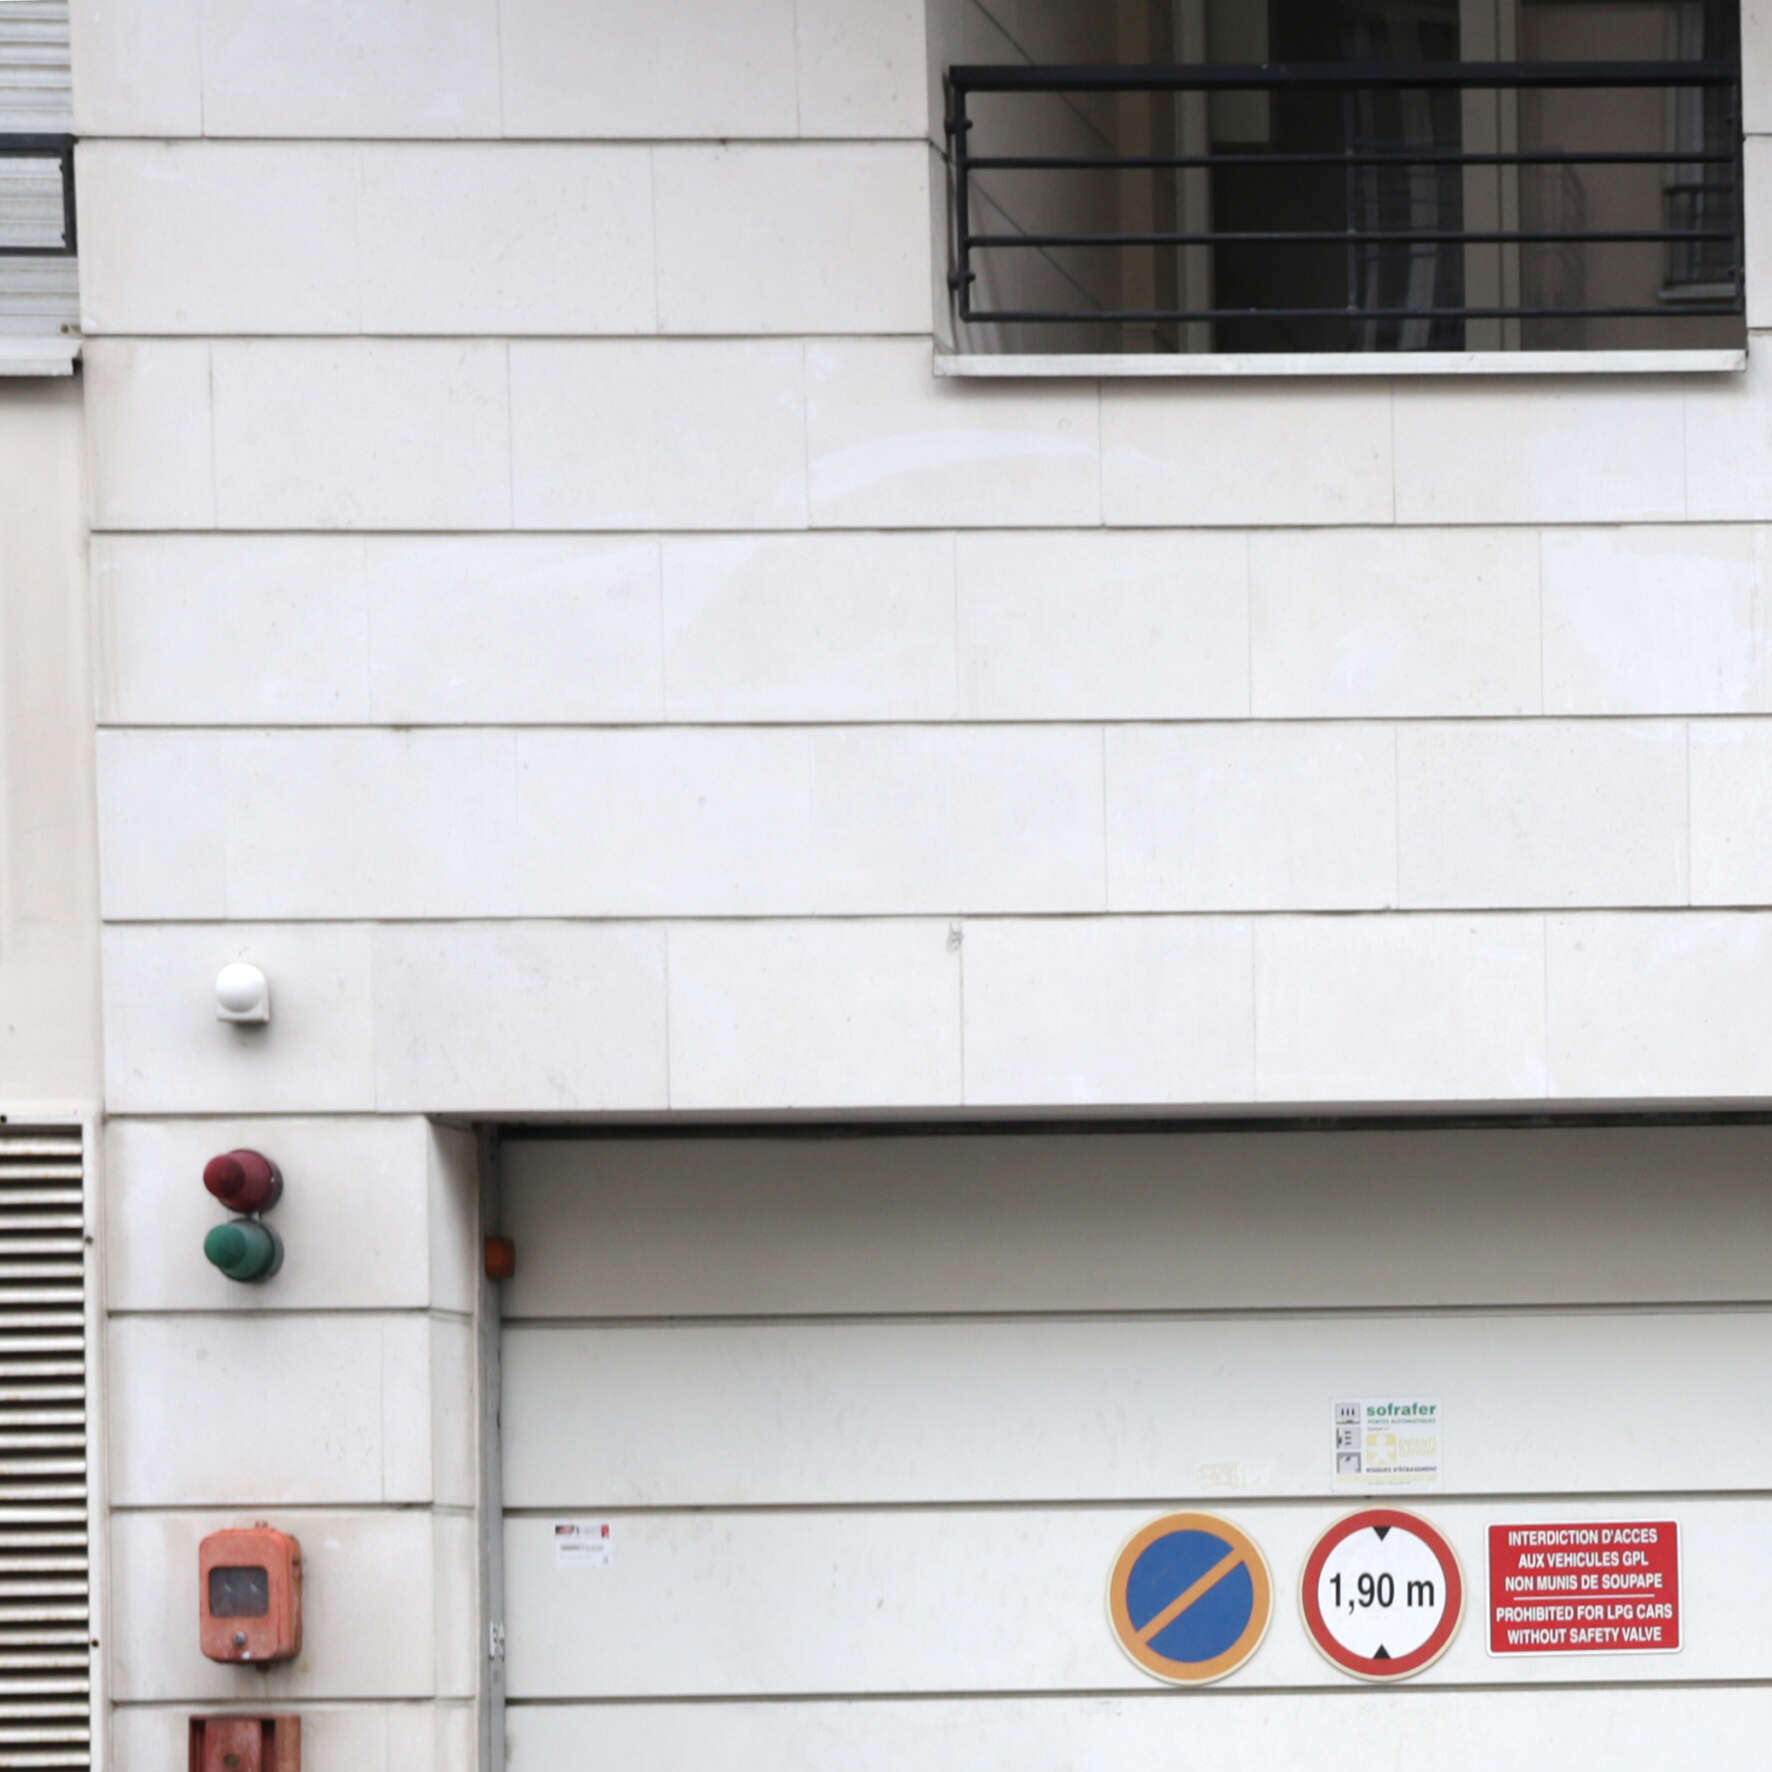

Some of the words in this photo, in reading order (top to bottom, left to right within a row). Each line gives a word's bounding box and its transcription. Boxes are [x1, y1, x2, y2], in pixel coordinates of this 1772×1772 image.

[1366, 1402, 1437, 1417] sofrafer
[1508, 1529, 1598, 1546] INTERDICTION
[1602, 1528, 1658, 1544] D'ACCES
[1518, 1553, 1545, 1568] AUX
[1547, 1551, 1619, 1567] VEHICULES
[1622, 1551, 1649, 1566] GPL
[1505, 1576, 1534, 1591] NON
[1536, 1575, 1578, 1590] MUNIS
[1581, 1574, 1599, 1589] DE
[1602, 1573, 1663, 1589] SOUPAPE
[1329, 1572, 1395, 1615] 1,90
[1407, 1580, 1435, 1607] m
[1496, 1605, 1574, 1622] PROHIBITED
[1577, 1605, 1604, 1620] FOR
[1607, 1604, 1633, 1619] LPG
[1636, 1603, 1673, 1619] CARS
[1507, 1628, 1567, 1644] WITHOUT
[1569, 1627, 1620, 1643] SAFETY
[1621, 1626, 1662, 1641] VALVE
